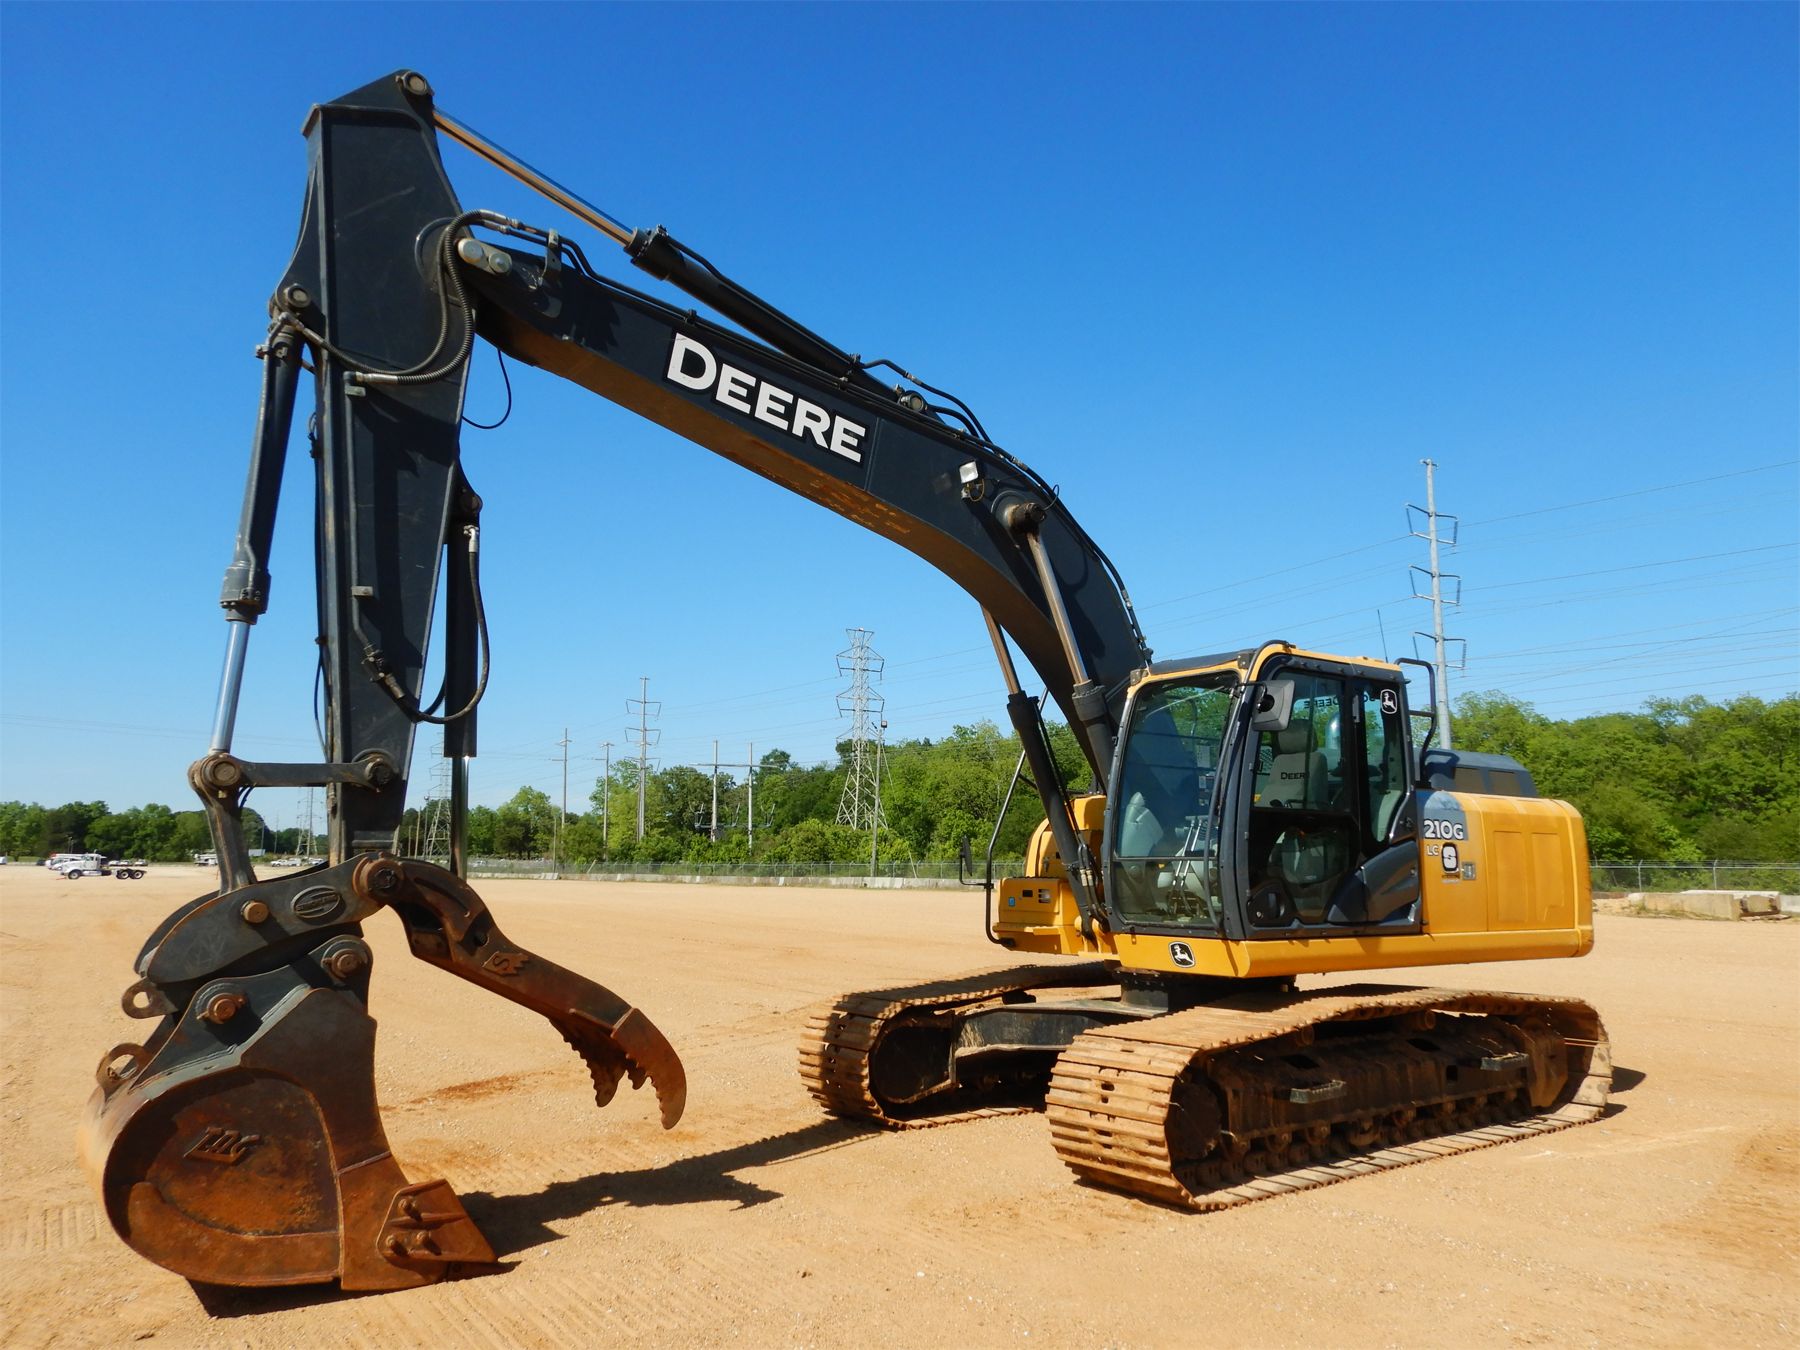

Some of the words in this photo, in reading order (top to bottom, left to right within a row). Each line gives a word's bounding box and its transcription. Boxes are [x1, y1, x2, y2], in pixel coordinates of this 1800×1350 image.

[667, 332, 866, 463] DEERE
[1280, 771, 1306, 780] DEER
[1423, 818, 1464, 840] 210G
[1426, 844, 1439, 856] LC
